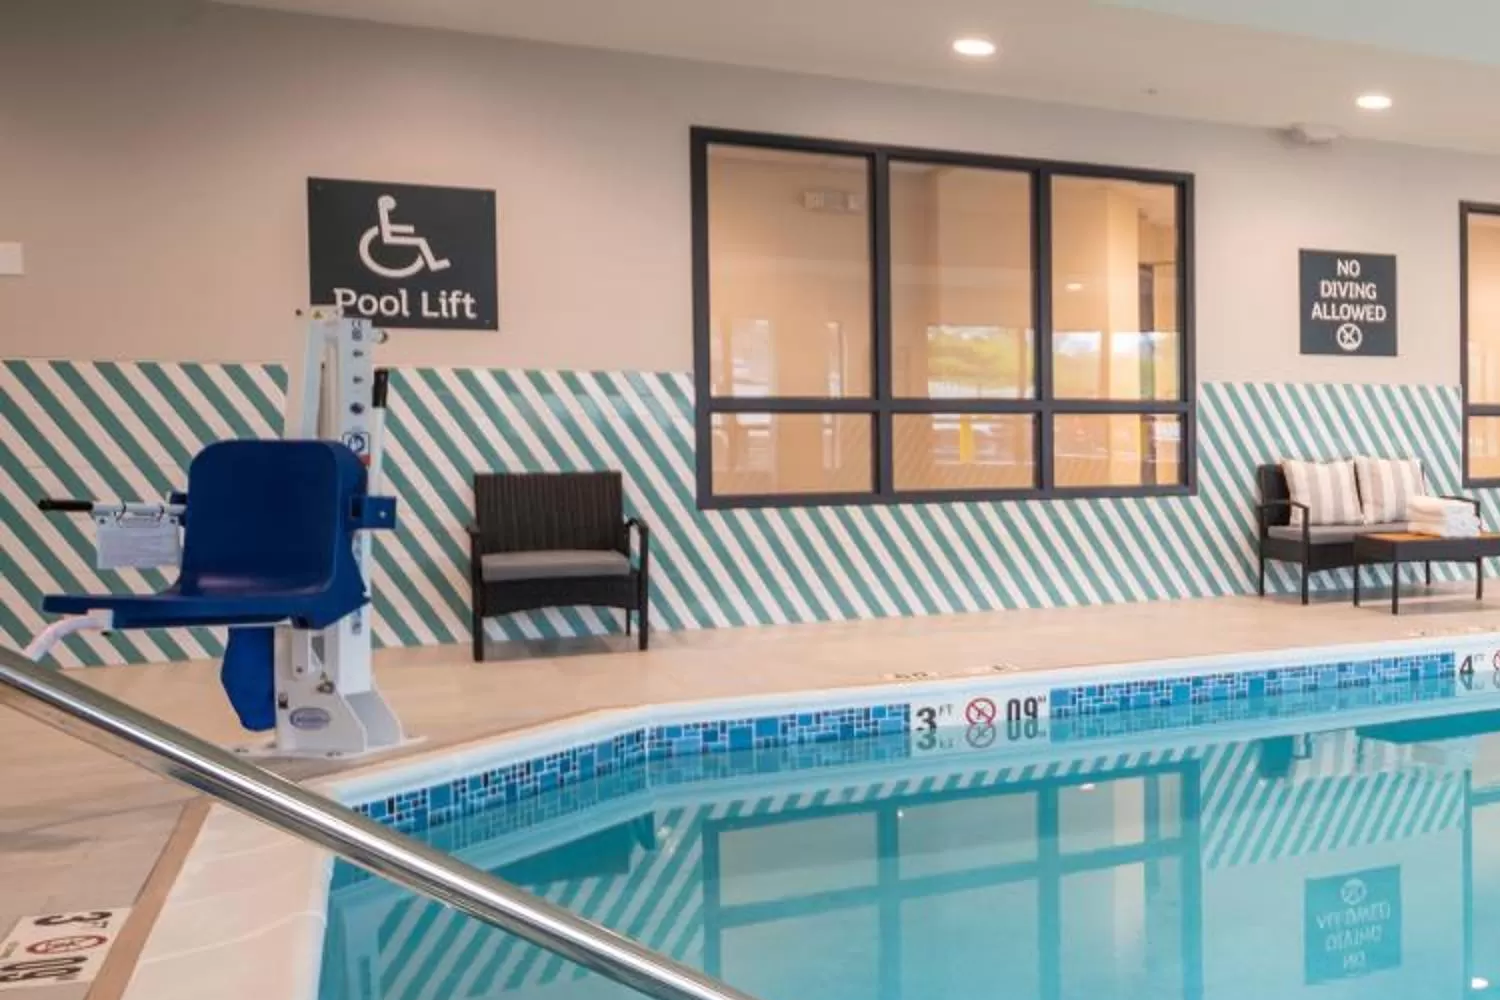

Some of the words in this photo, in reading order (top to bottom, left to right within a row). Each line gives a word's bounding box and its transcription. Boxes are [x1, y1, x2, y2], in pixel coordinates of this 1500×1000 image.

[1337, 258, 1361, 278] NO
[1320, 279, 1377, 300] DIVING
[333, 287, 410, 318] Pool
[421, 289, 477, 318] Lift
[1311, 301, 1387, 321] ALLOWED
[1459, 654, 1474, 674] 4
